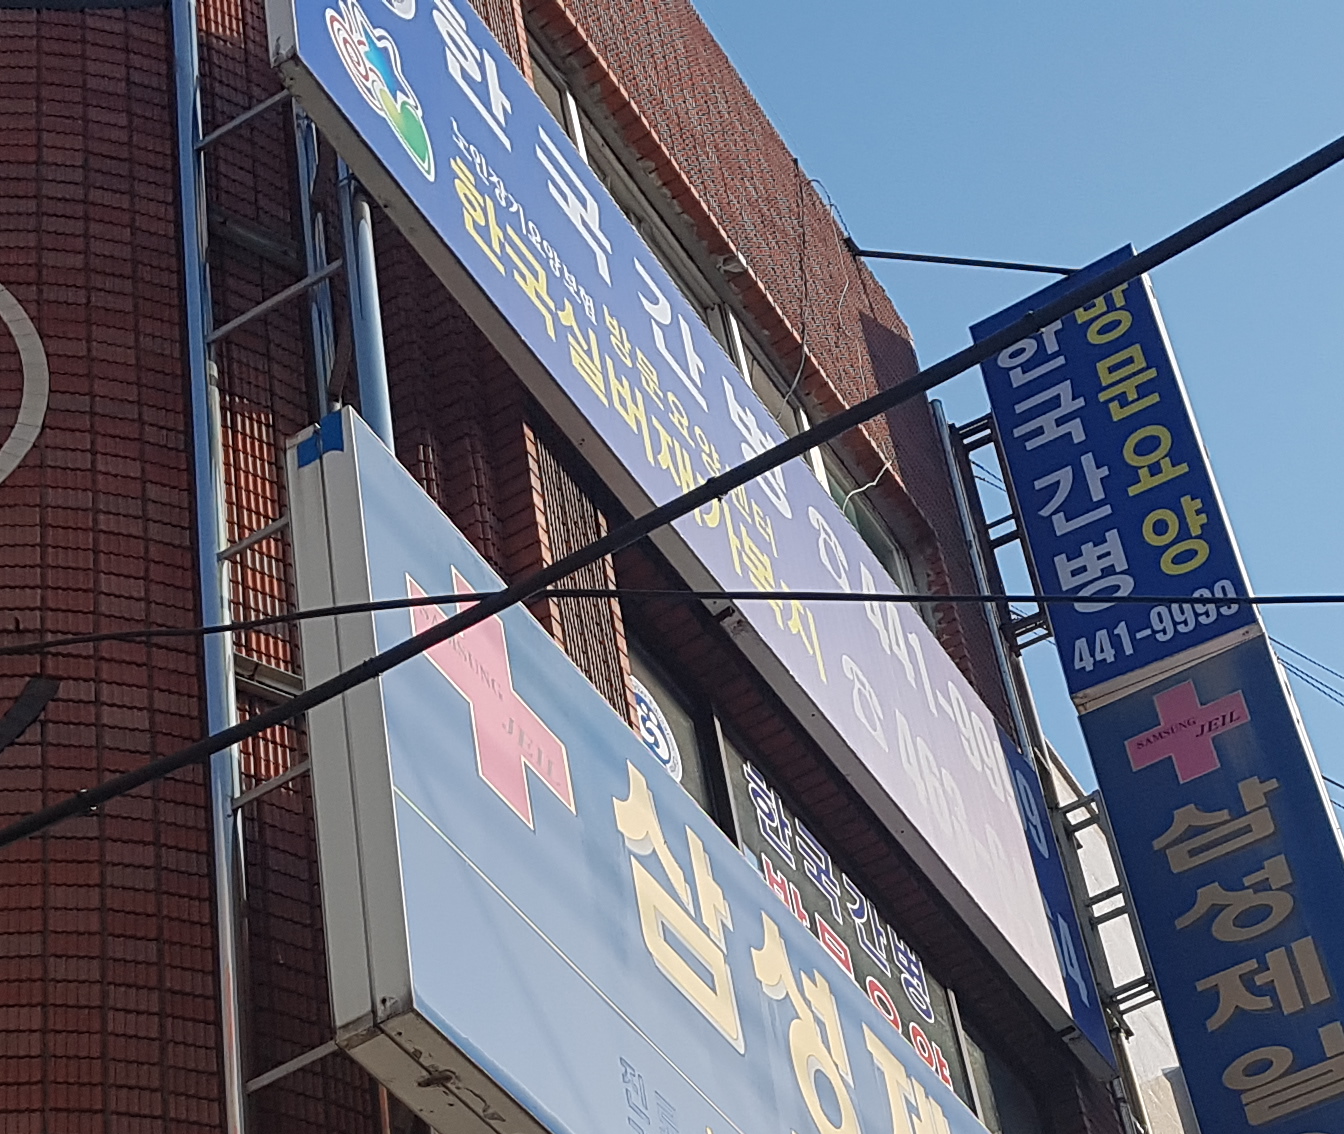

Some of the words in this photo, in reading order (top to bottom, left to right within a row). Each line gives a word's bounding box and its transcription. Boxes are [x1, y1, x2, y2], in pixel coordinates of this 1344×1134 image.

[1074, 280, 1210, 576] 방문요양
[419, 606, 504, 702] SASUNG
[1072, 578, 1241, 673] 441-9999
[501, 716, 561, 786] JEIL
[859, 560, 1050, 860] 441-9999
[1136, 716, 1198, 751] SAMSUNG
[1195, 709, 1241, 738] JEIL
[742, 760, 934, 1024] 한국간병
